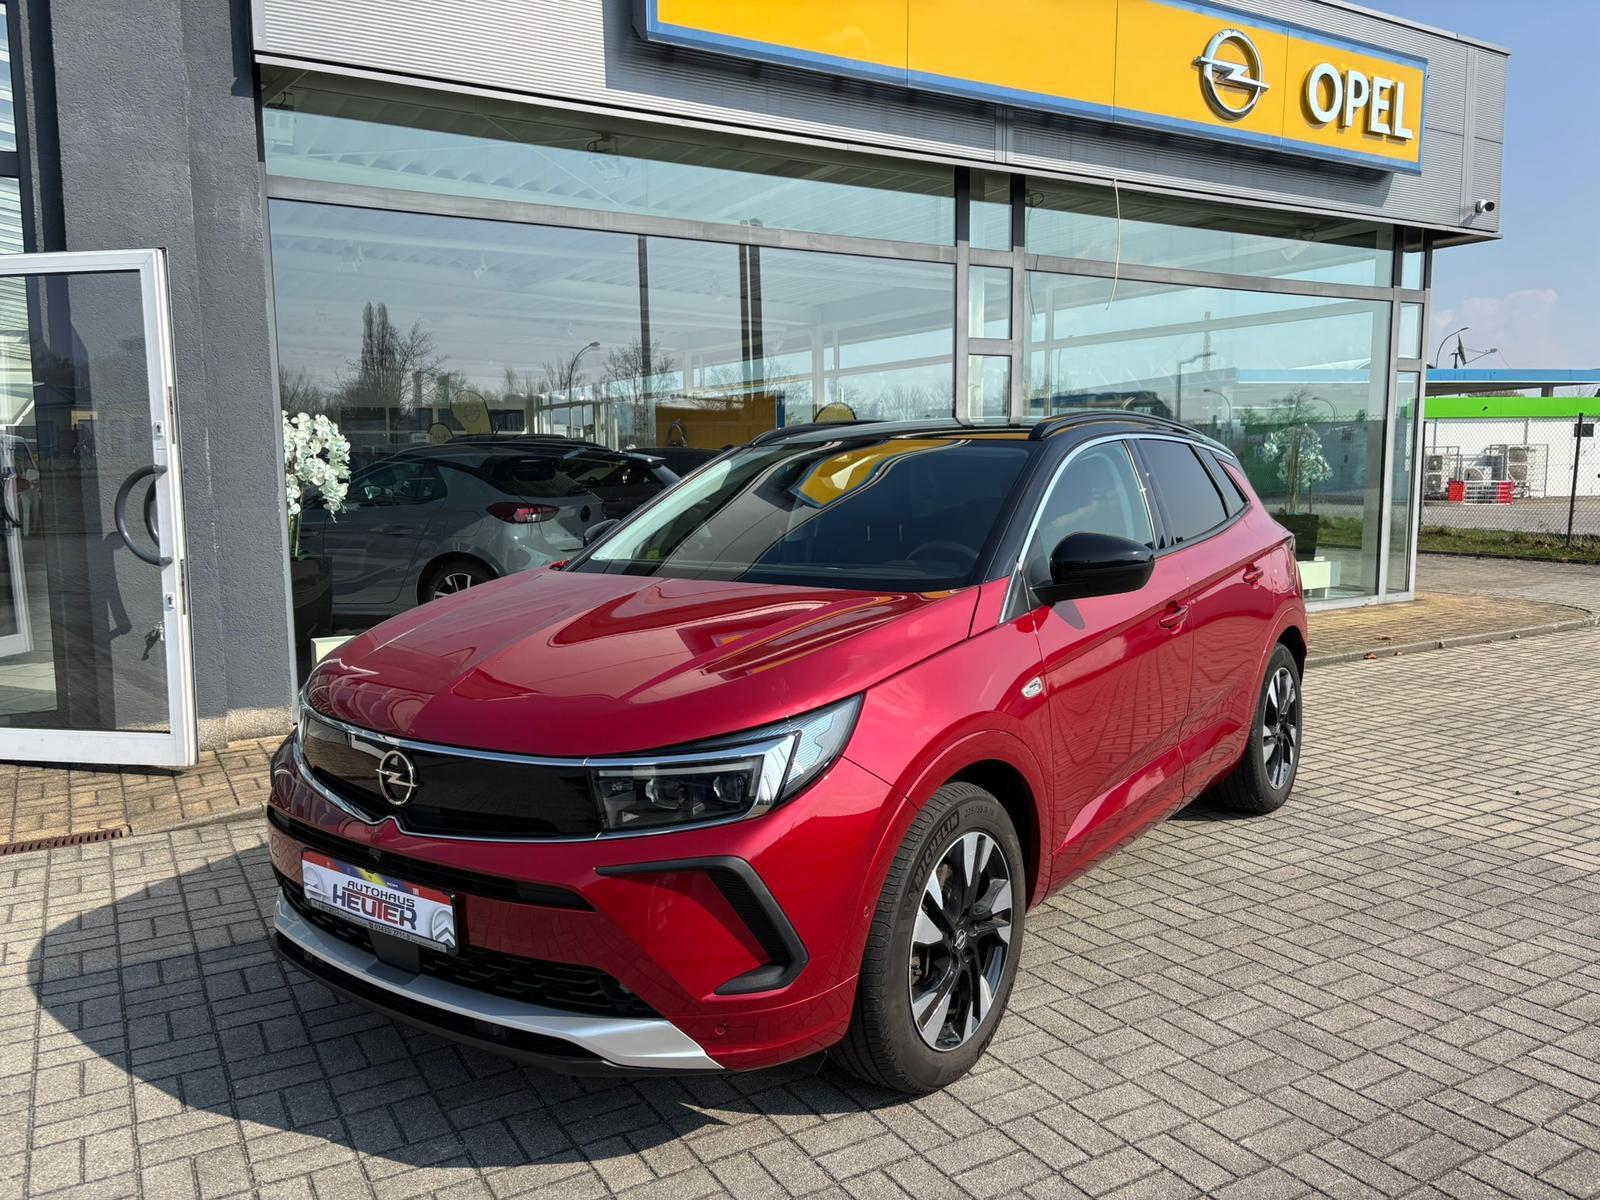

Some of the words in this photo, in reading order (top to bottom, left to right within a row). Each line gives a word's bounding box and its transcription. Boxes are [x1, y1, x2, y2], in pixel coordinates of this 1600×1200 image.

[1308, 62, 1413, 141] OPEL
[915, 814, 959, 889] MICHELIN
[332, 883, 418, 931] HEUTER
[347, 880, 415, 907] AUTOHAUS
